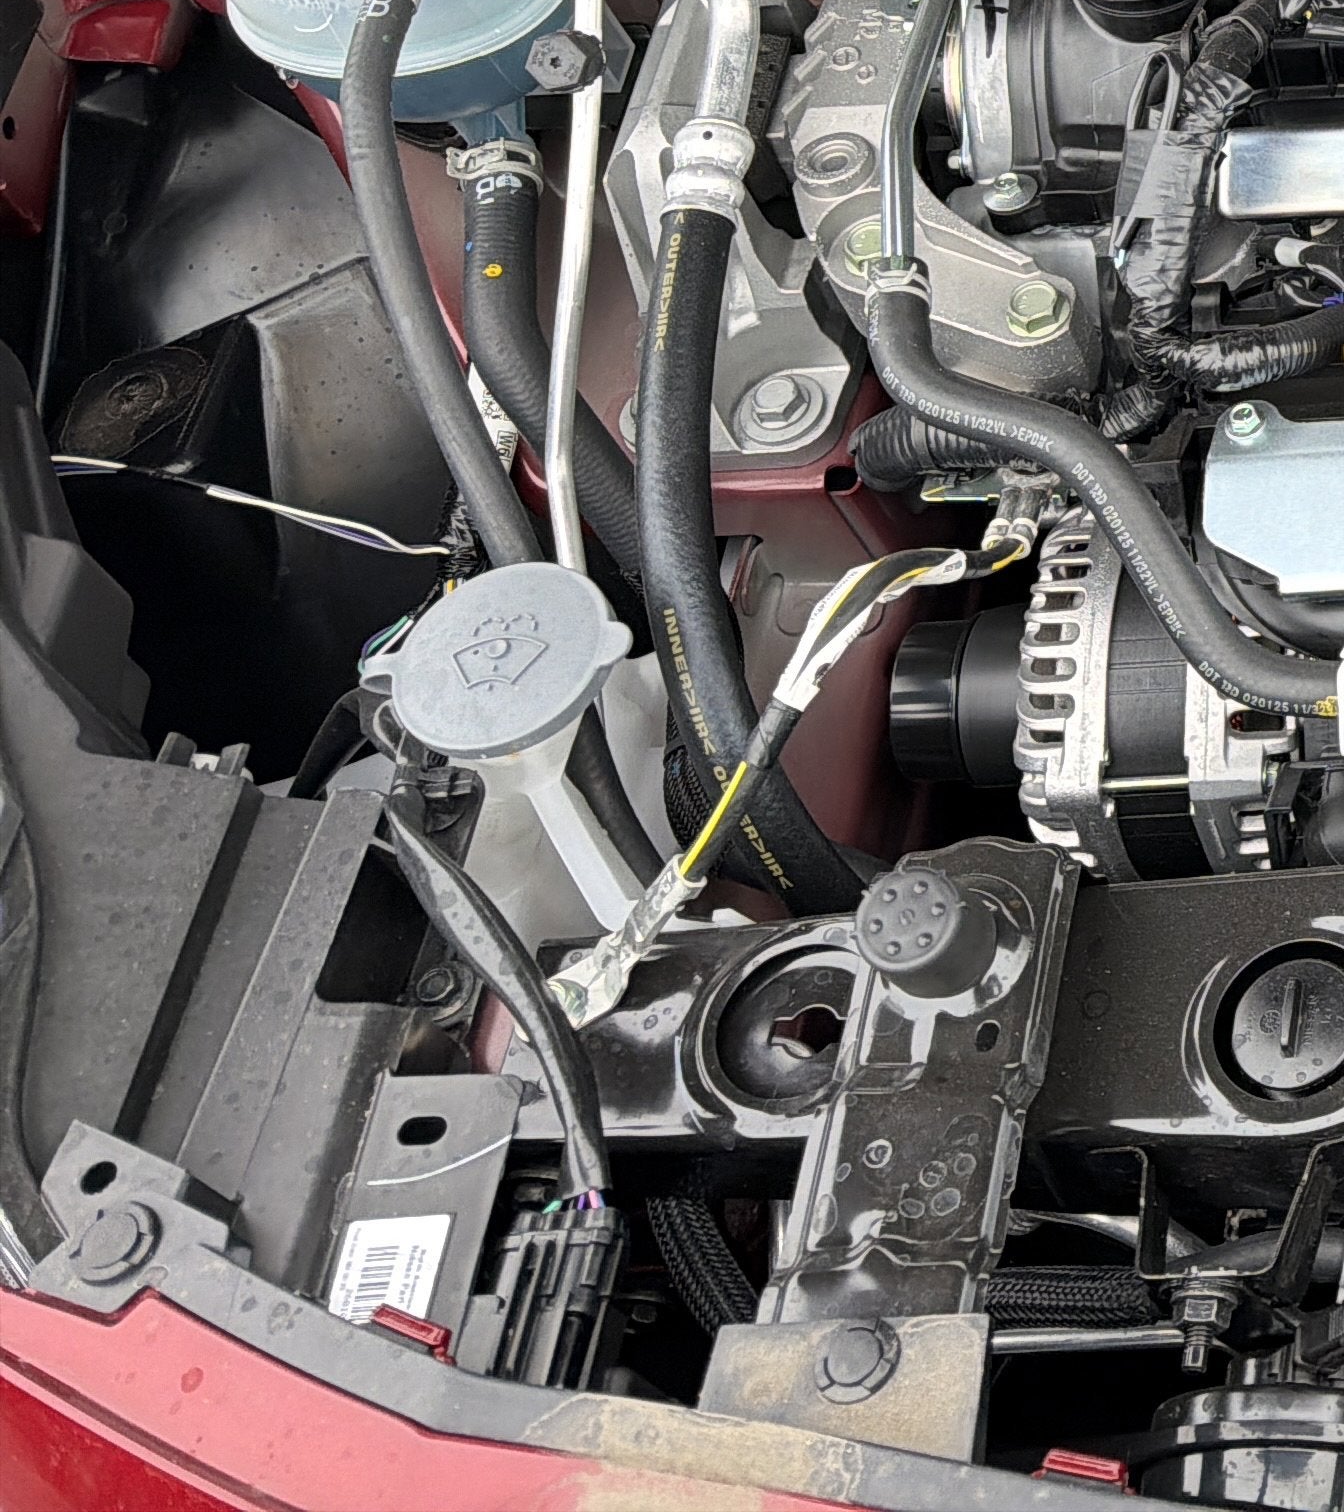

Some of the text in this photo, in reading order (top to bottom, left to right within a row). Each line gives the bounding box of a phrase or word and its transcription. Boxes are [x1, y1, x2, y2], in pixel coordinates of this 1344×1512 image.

[882, 366, 899, 390] DOT
[918, 399, 961, 424] 020125
[1071, 462, 1095, 486] DOT
[1102, 505, 1135, 549] 020125
[1198, 660, 1221, 682] DOT
[1242, 692, 1290, 713] 020125
